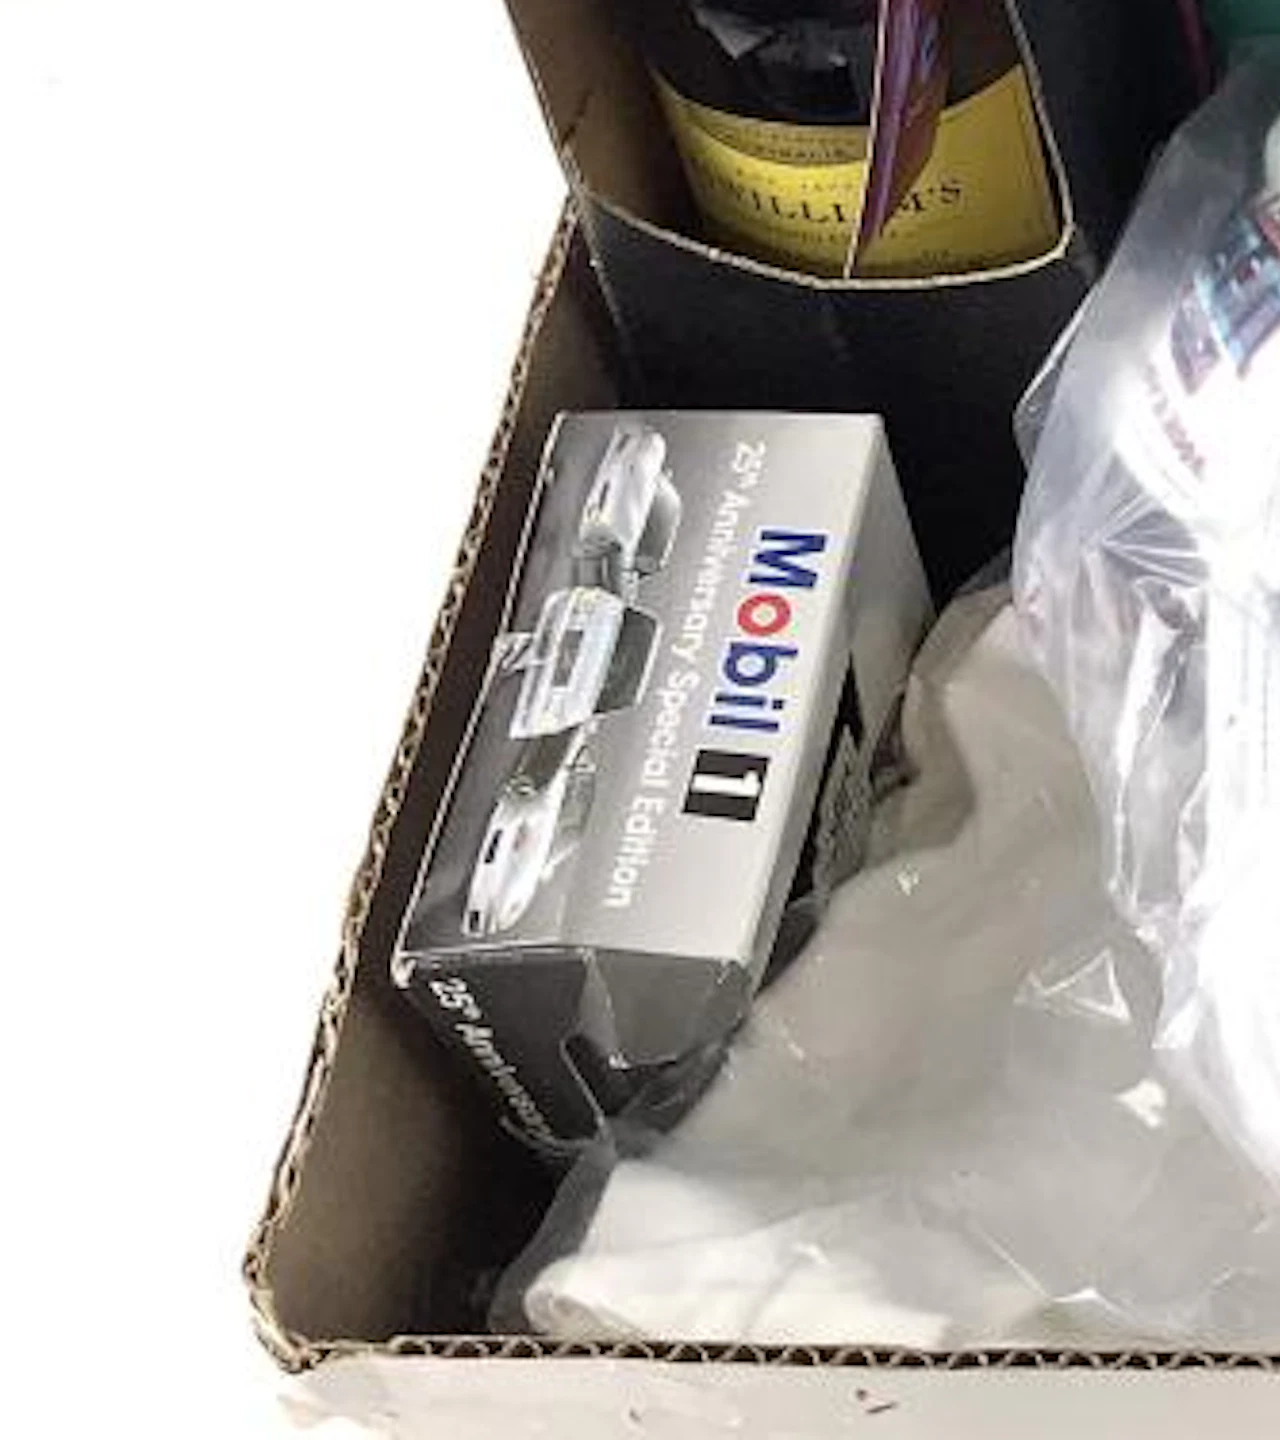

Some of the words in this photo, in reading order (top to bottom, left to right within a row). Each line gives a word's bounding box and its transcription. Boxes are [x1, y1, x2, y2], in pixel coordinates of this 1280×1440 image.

[670, 489, 753, 662] Anniversary
[708, 528, 829, 733] Mobil
[640, 669, 701, 788] Special
[601, 795, 666, 908] Edition
